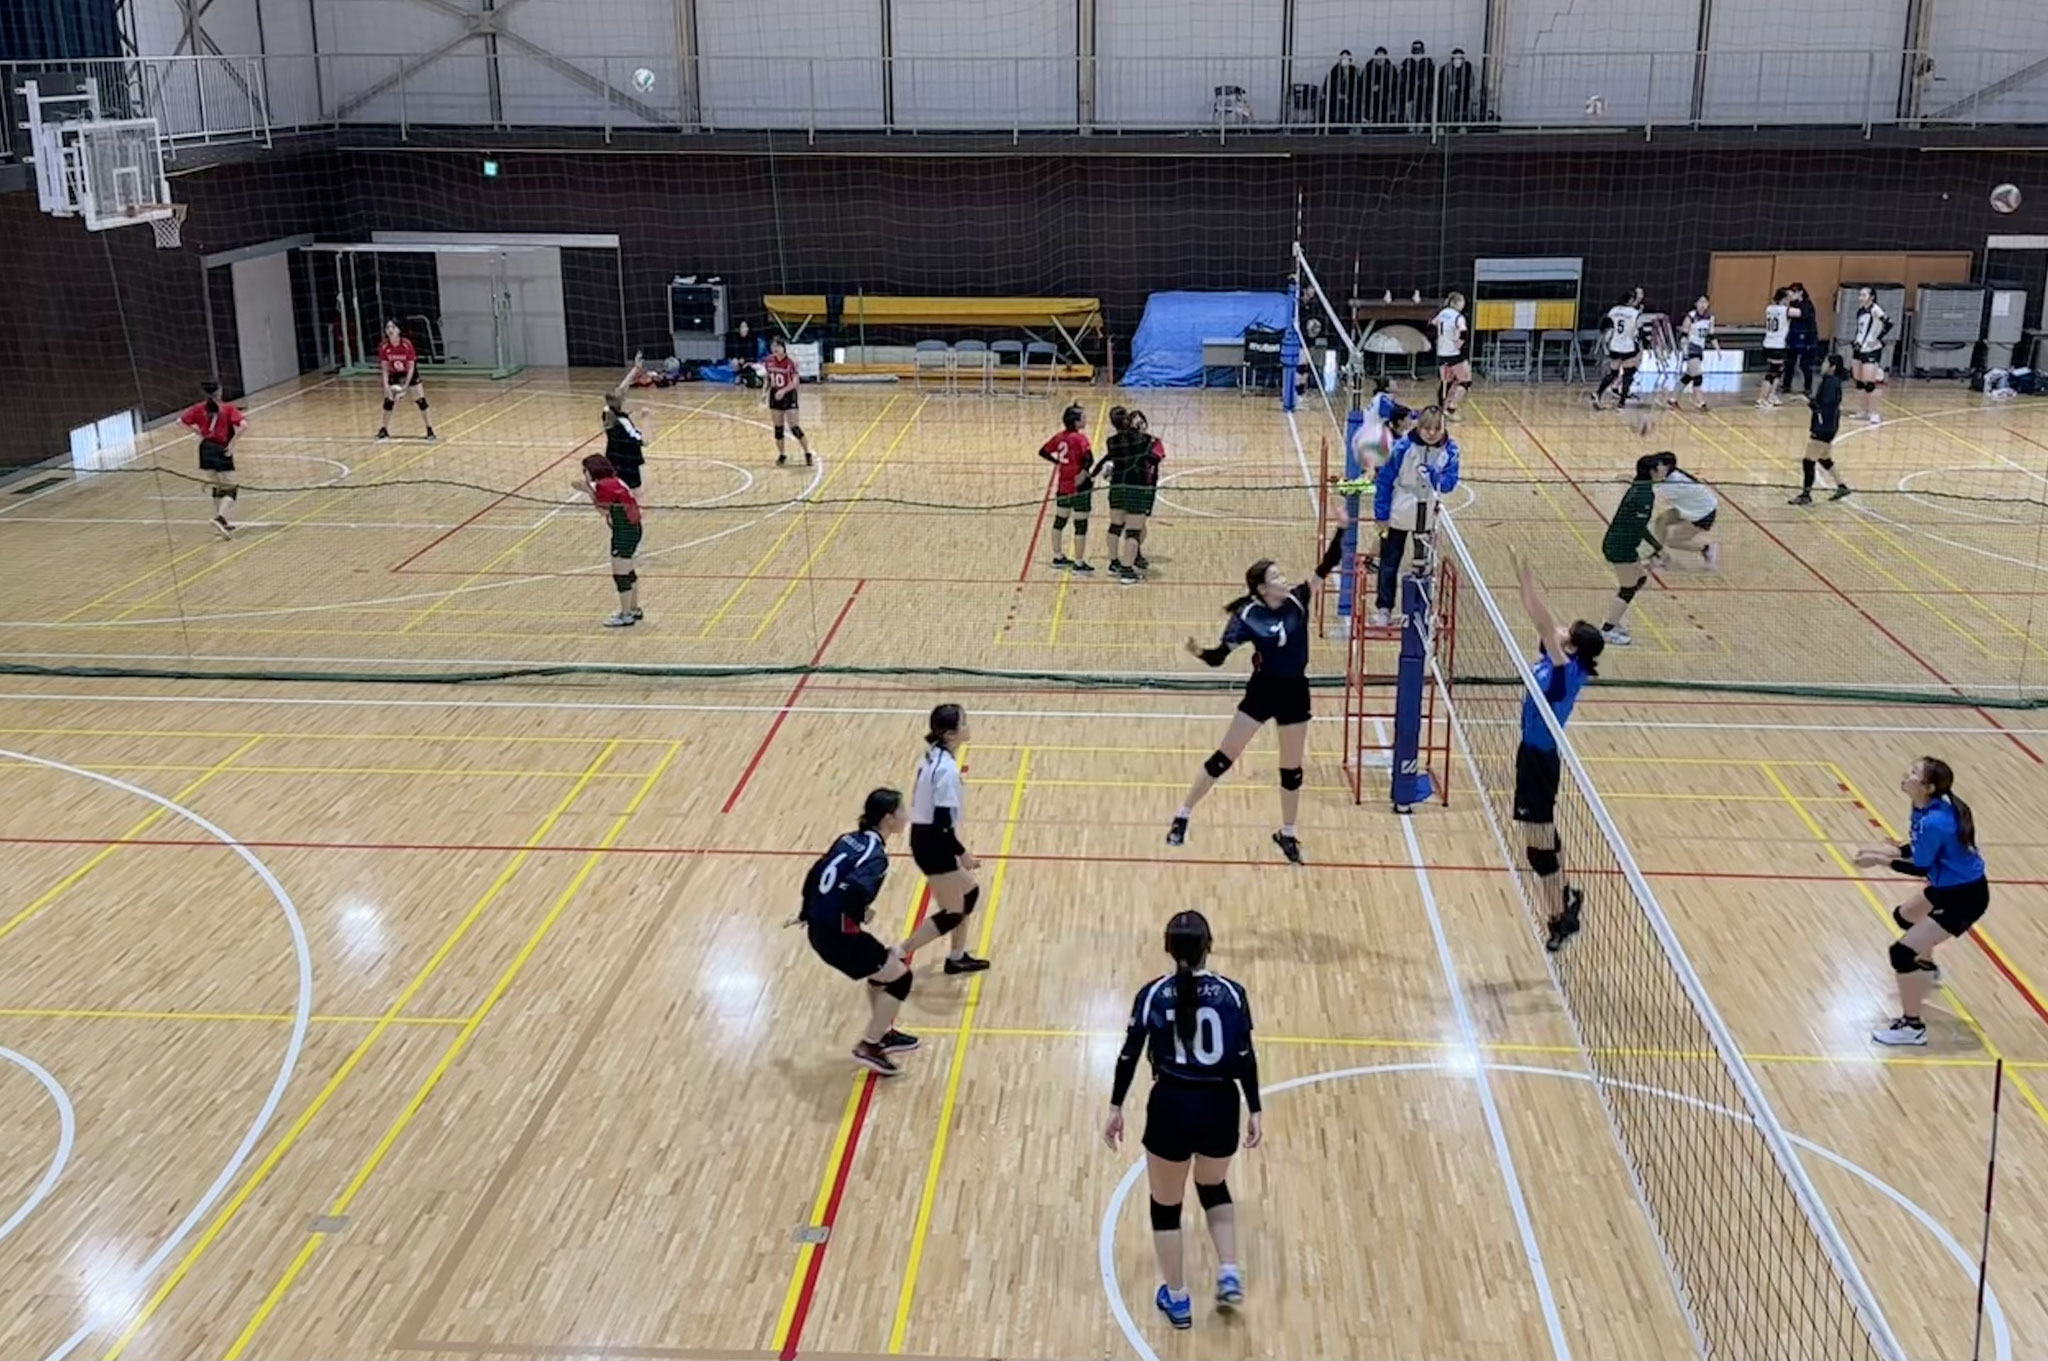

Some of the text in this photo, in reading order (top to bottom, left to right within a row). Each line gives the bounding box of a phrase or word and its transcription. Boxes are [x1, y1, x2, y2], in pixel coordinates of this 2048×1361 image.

[1766, 316, 1779, 332] 10
[769, 372, 785, 388] 10
[1057, 441, 1069, 464] 2
[818, 851, 849, 896] 6
[1165, 1006, 1224, 1066] 10
